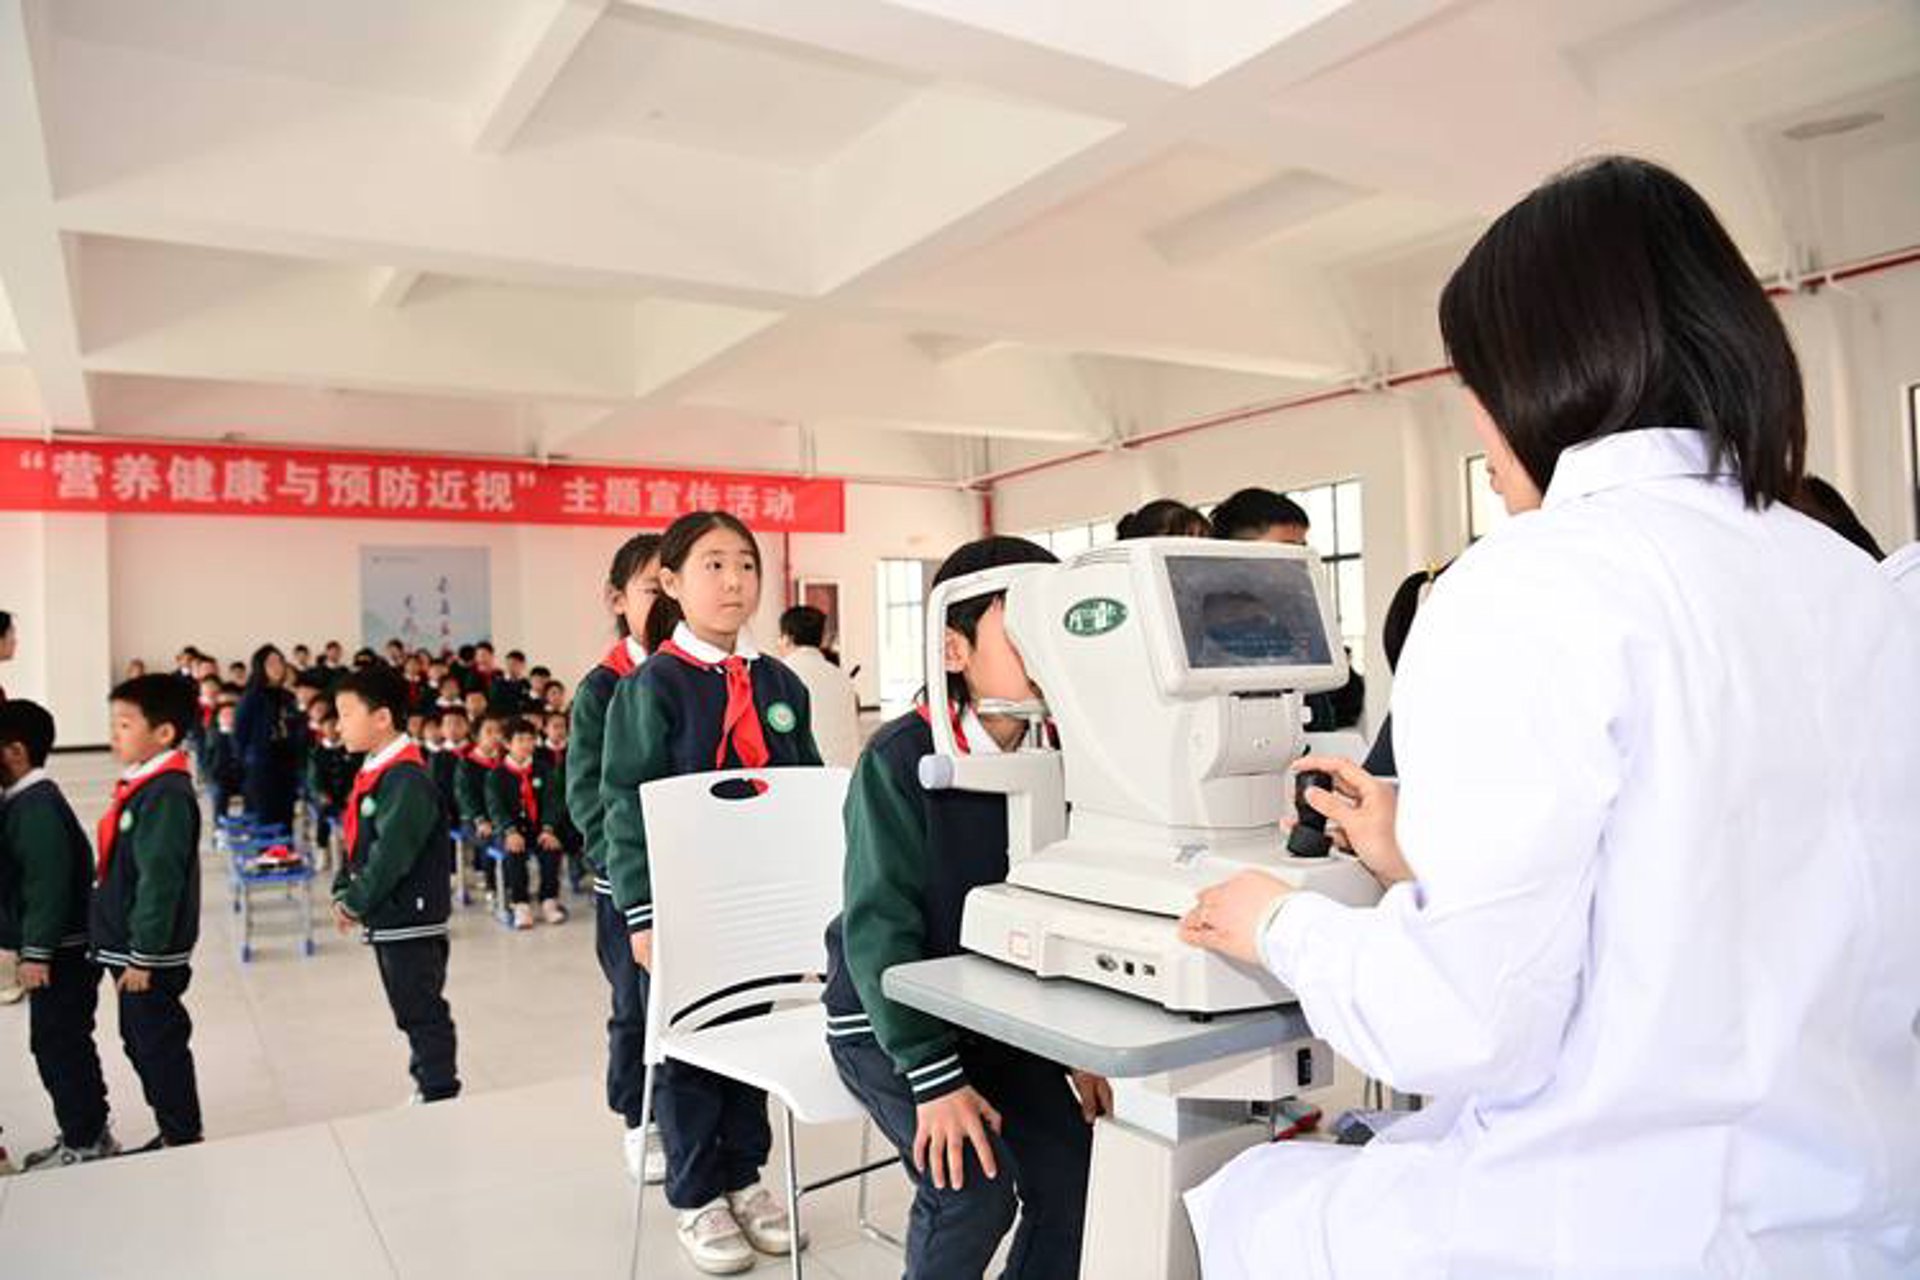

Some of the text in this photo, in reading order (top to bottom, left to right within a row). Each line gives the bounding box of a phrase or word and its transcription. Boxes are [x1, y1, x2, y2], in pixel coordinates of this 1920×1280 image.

[18, 449, 796, 522] “营养健康与预防近视” 主题宣传活动
